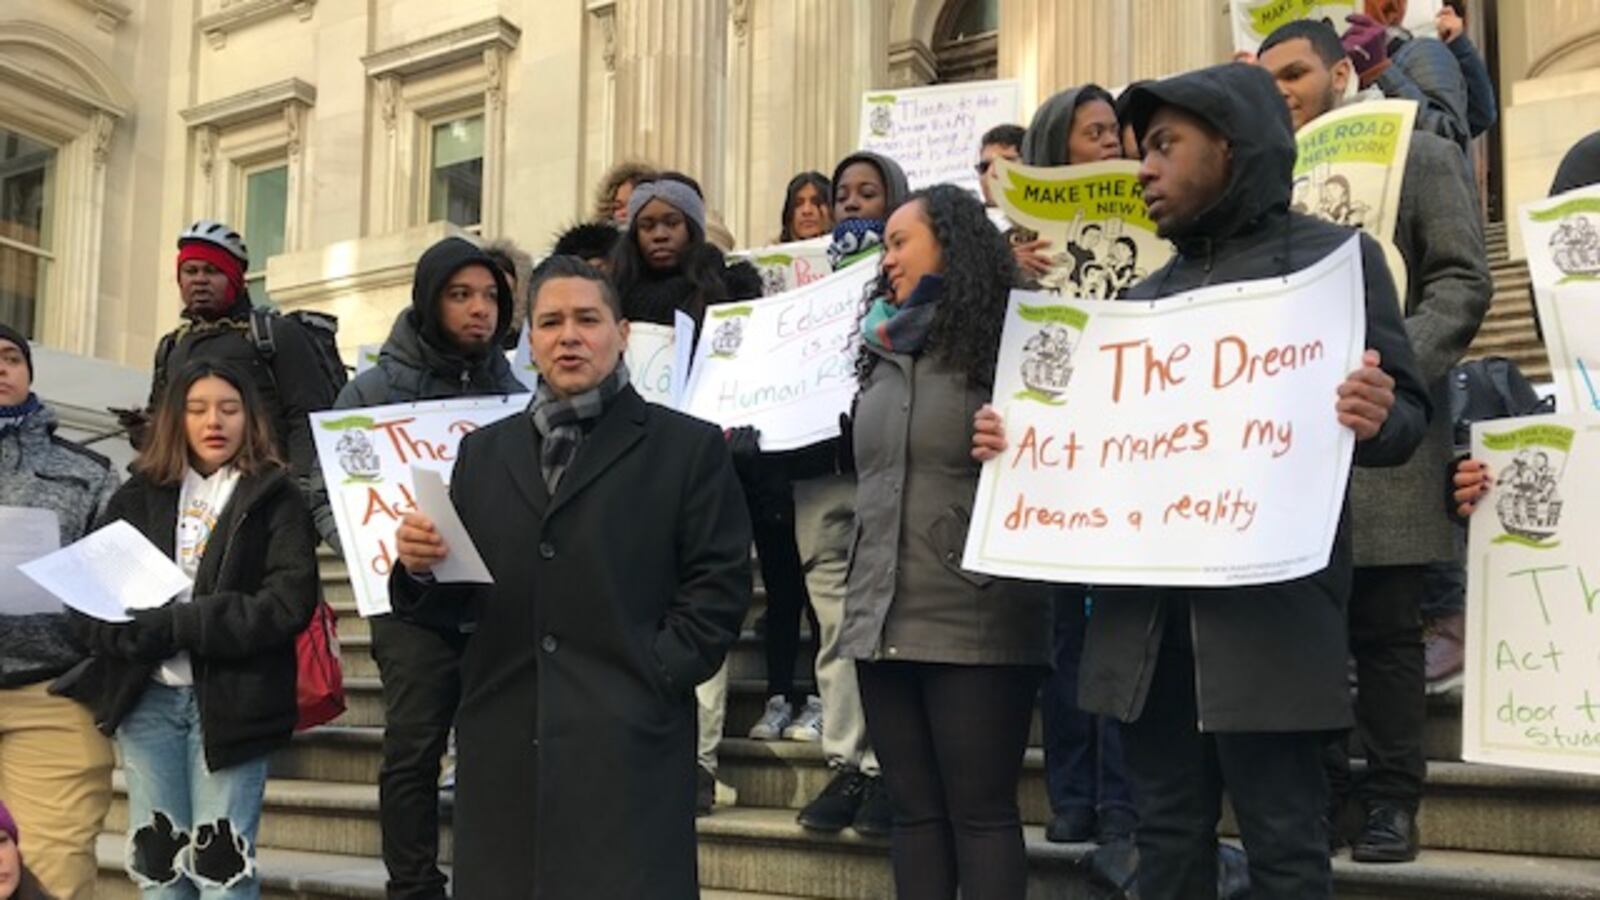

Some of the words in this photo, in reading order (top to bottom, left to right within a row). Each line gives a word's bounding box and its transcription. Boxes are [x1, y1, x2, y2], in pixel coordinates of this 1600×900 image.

[1333, 120, 1397, 140] ROAD
[1023, 184, 1081, 204] MAKE
[1084, 179, 1127, 199] THE
[1096, 201, 1136, 217] NEW
[1099, 337, 1192, 404] The
[1210, 334, 1324, 391] Dream
[368, 416, 455, 464] The
[1010, 425, 1084, 471] Act
[1099, 418, 1210, 469] makes
[1241, 416, 1293, 459] my
[1003, 493, 1109, 532] dreams
[1126, 510, 1142, 530] a
[1163, 487, 1258, 532] reality
[1495, 638, 1564, 673] Act
